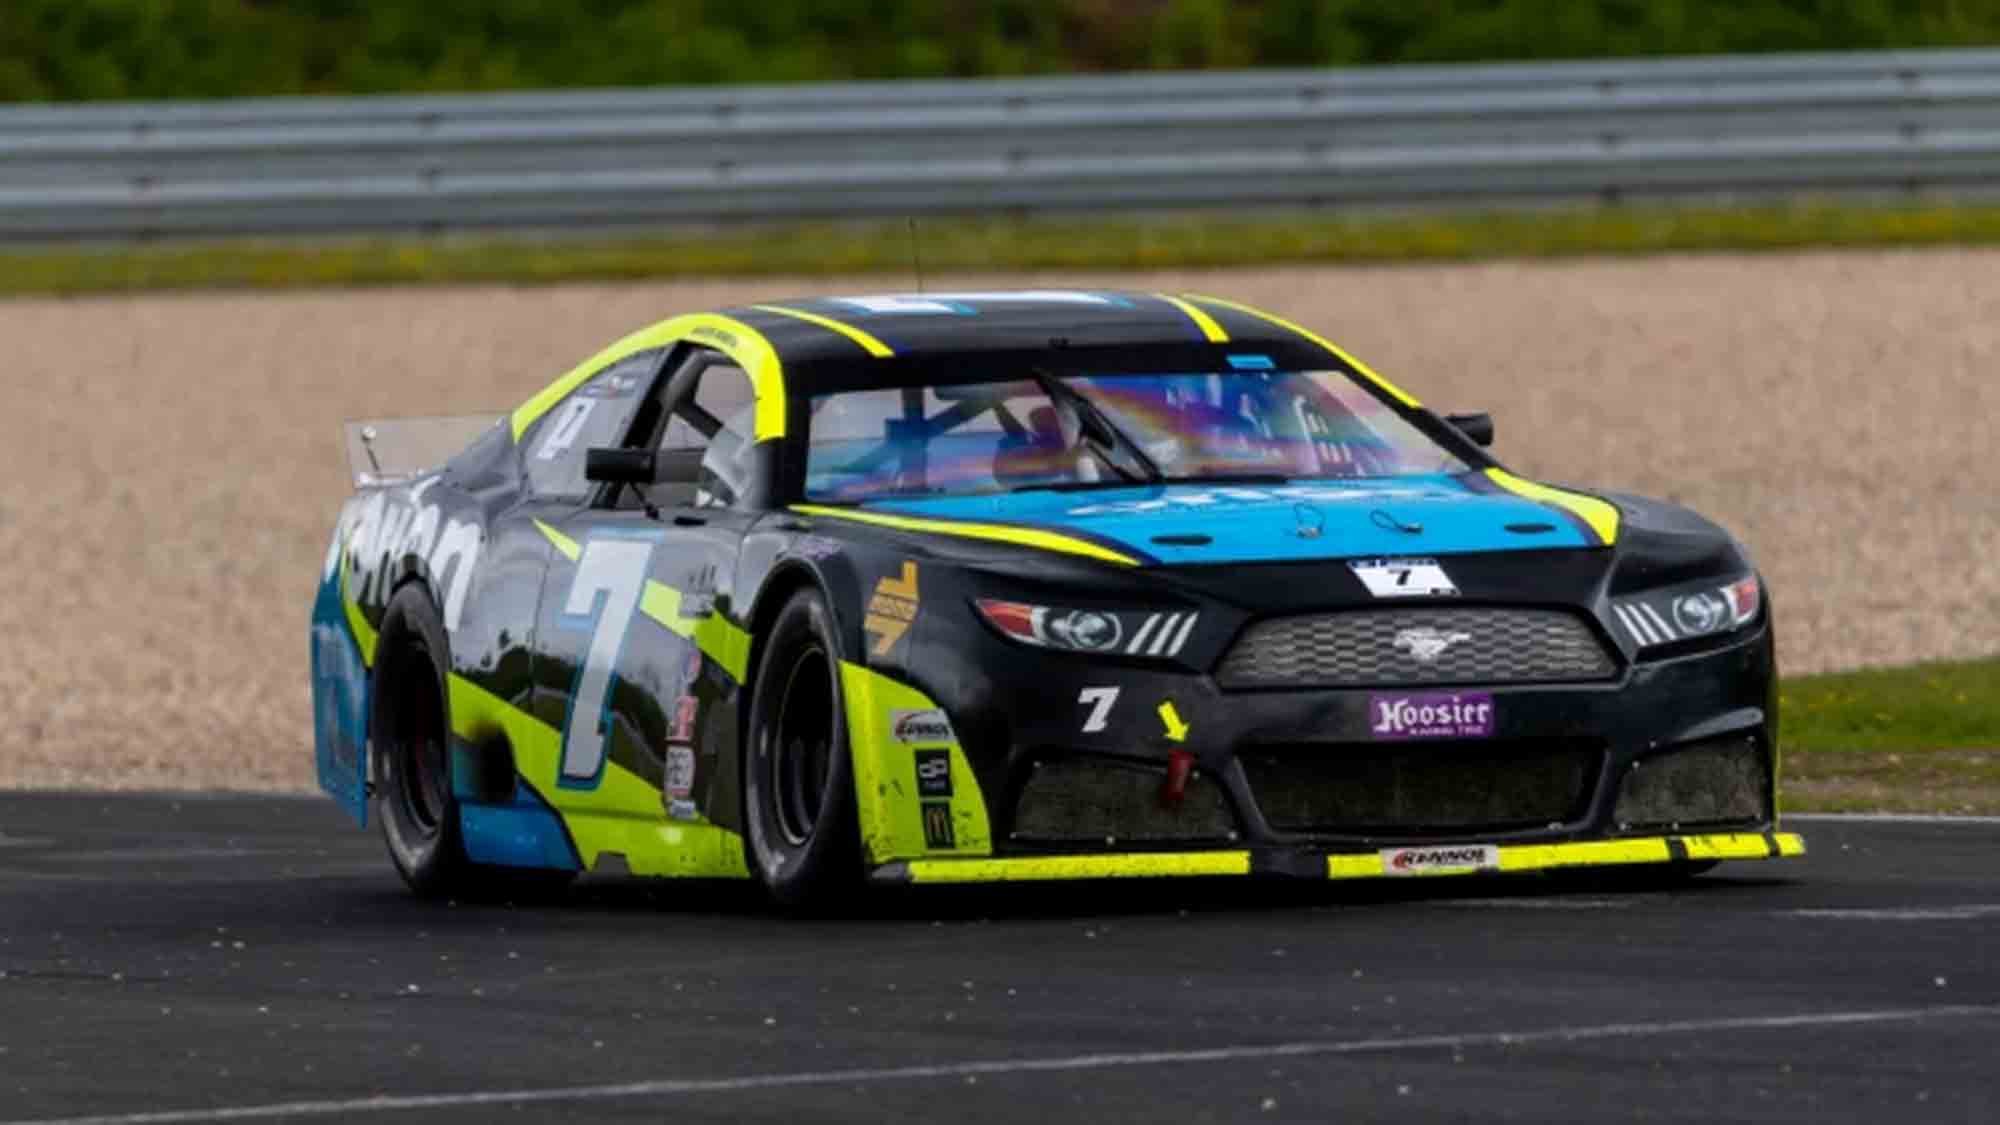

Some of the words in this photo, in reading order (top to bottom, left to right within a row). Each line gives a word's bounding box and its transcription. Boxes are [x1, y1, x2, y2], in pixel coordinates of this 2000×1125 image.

[1387, 568, 1411, 587] 7
[560, 536, 656, 784] 7
[1077, 686, 1121, 733] 7
[1373, 695, 1490, 733] Hoosier
